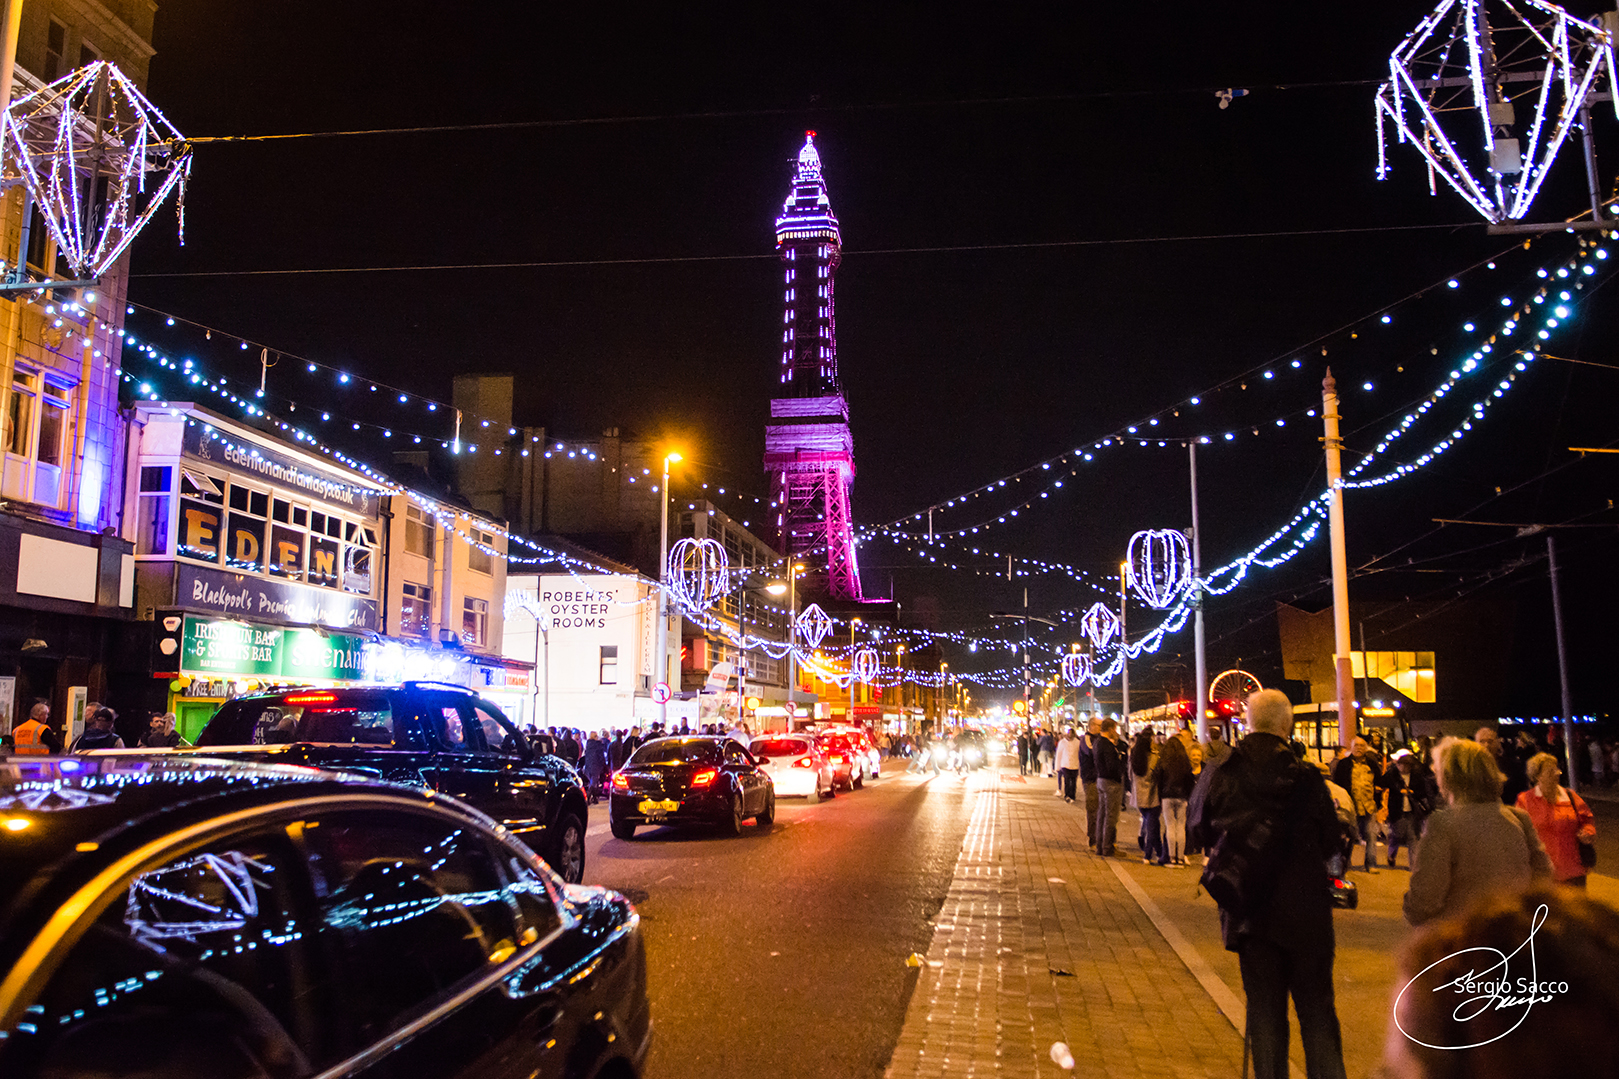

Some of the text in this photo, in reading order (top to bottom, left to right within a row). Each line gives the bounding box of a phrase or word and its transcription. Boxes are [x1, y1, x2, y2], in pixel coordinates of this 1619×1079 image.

[185, 508, 335, 580] EDEN
[192, 580, 252, 612] Blackpool's
[347, 609, 367, 627] Club
[551, 604, 609, 615] OYSTER
[552, 617, 606, 628] ROOMS
[195, 623, 276, 646] IRISH FUN BAR
[196, 641, 272, 662] & SPORTS BAR
